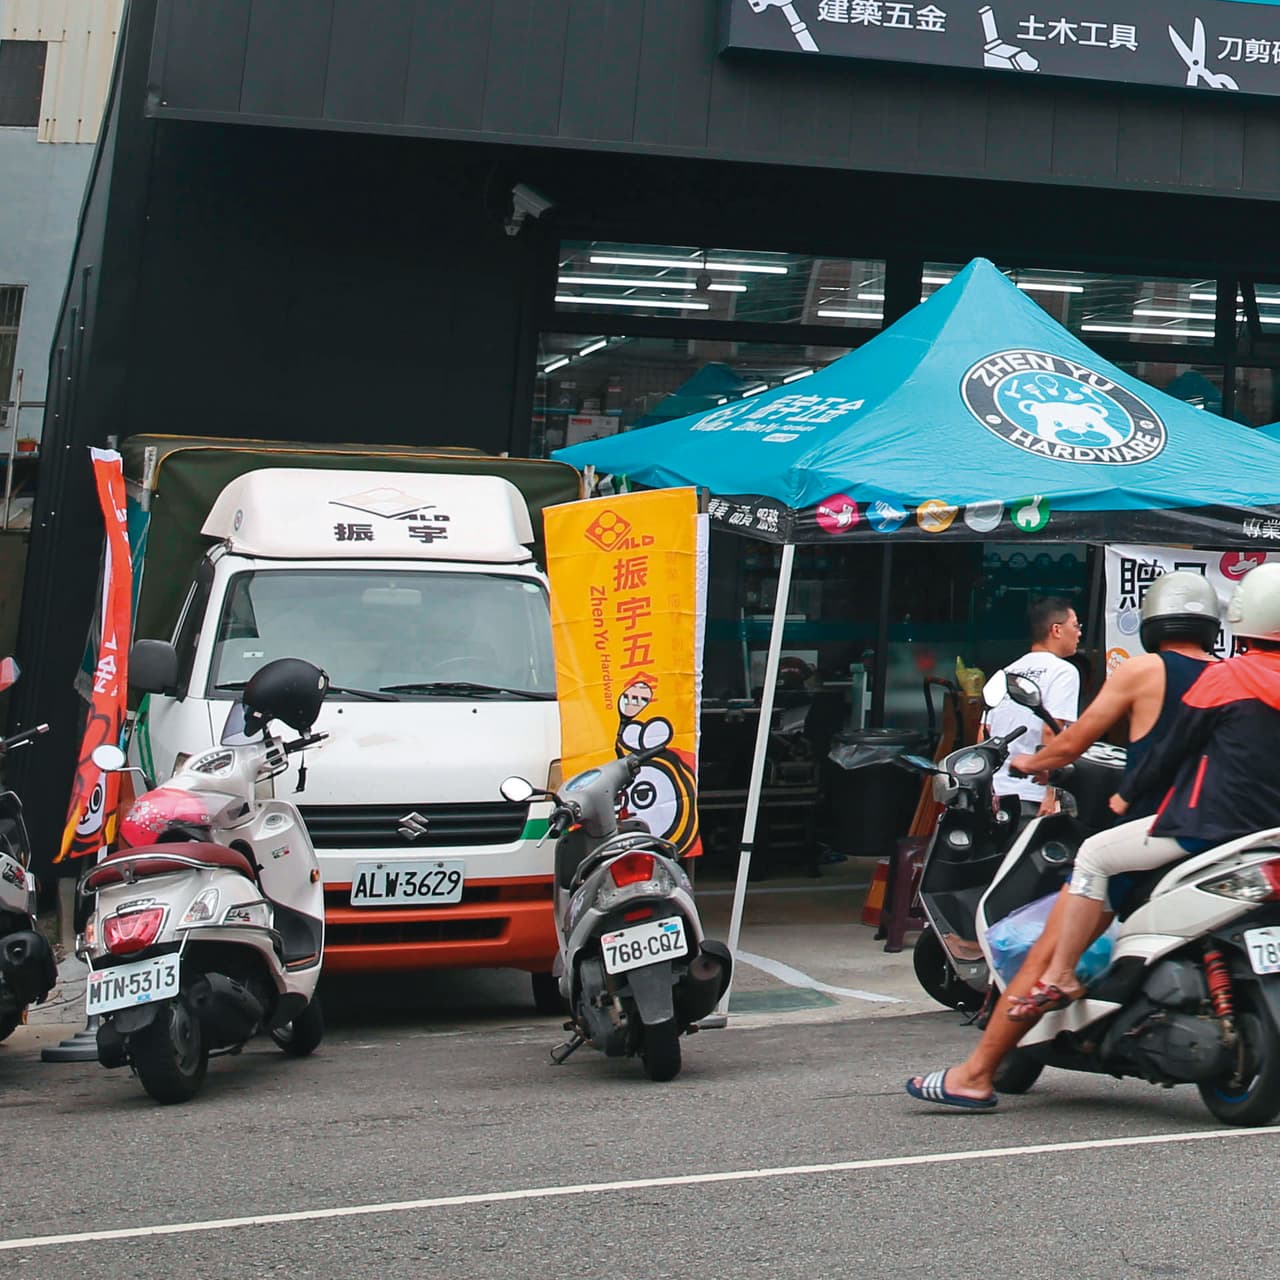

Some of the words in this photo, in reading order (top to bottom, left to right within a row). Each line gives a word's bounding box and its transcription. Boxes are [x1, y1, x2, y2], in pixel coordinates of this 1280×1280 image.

[1017, 15, 1138, 52] 土木工具
[971, 353, 1056, 387] ZHEN
[1064, 362, 1114, 392] YU
[1008, 429, 1160, 462] HARDWARE
[601, 654, 613, 711] Hardware
